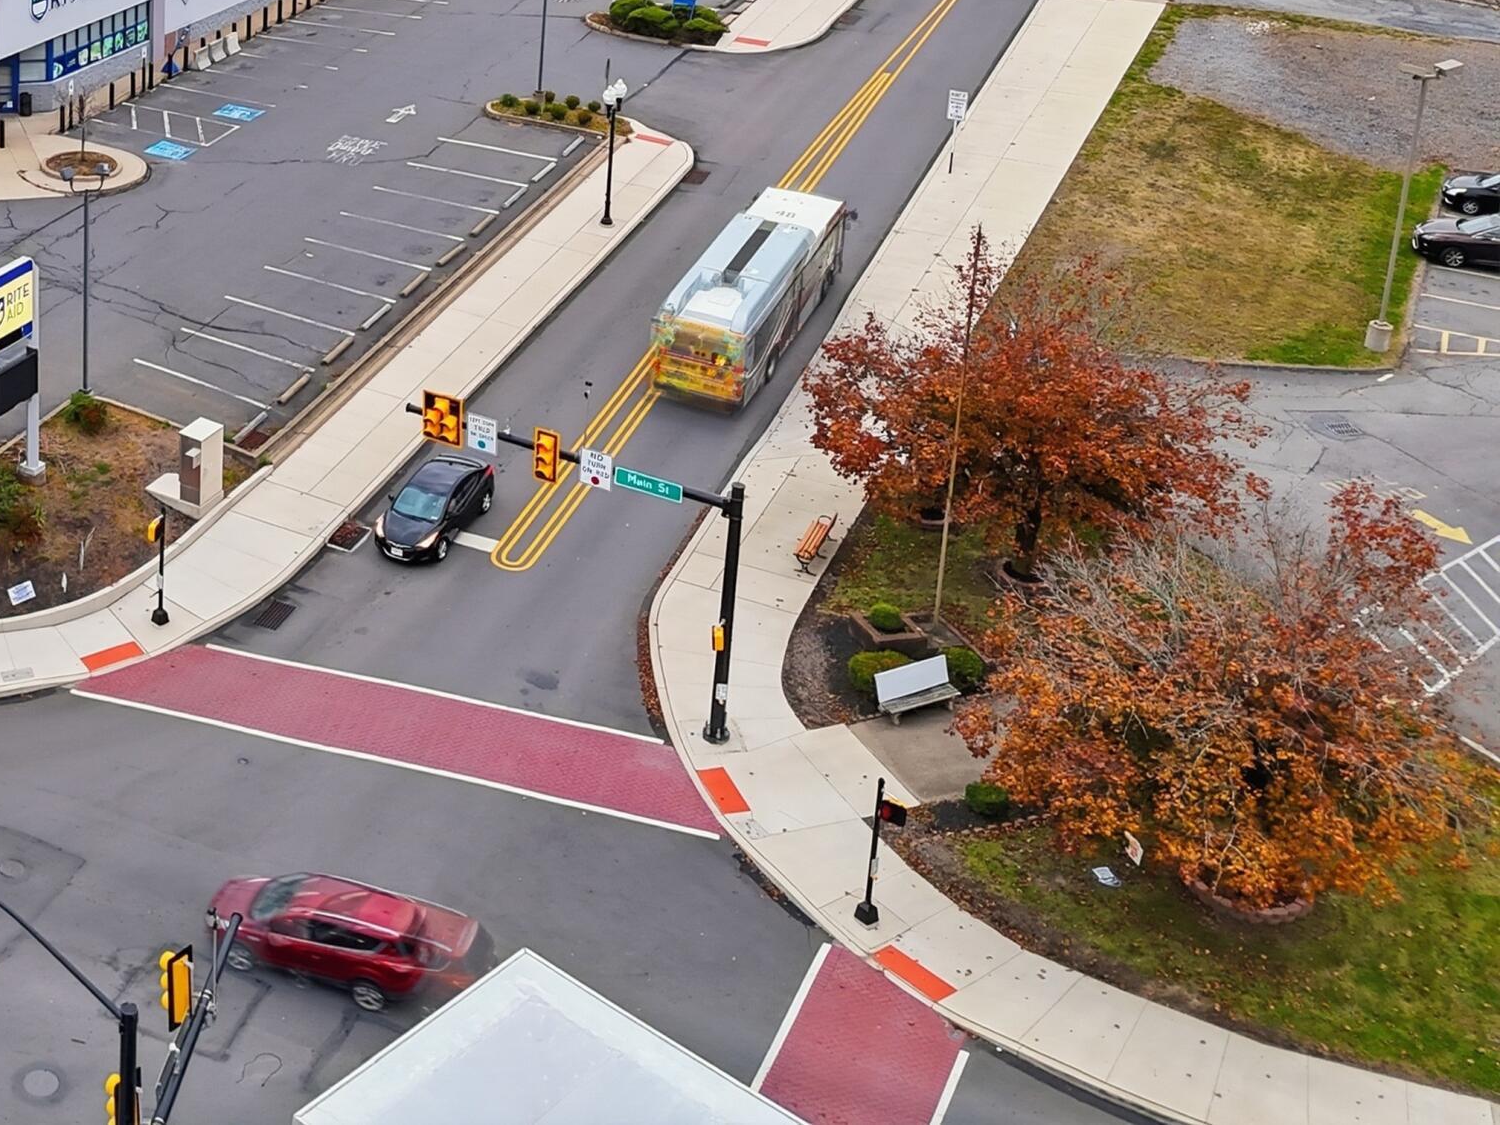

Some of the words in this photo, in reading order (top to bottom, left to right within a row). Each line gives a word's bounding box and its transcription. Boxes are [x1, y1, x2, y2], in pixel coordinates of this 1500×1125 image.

[6, 282, 30, 307] RITE
[6, 301, 25, 322] AID
[627, 473, 653, 490] Main
[657, 482, 670, 495] St
